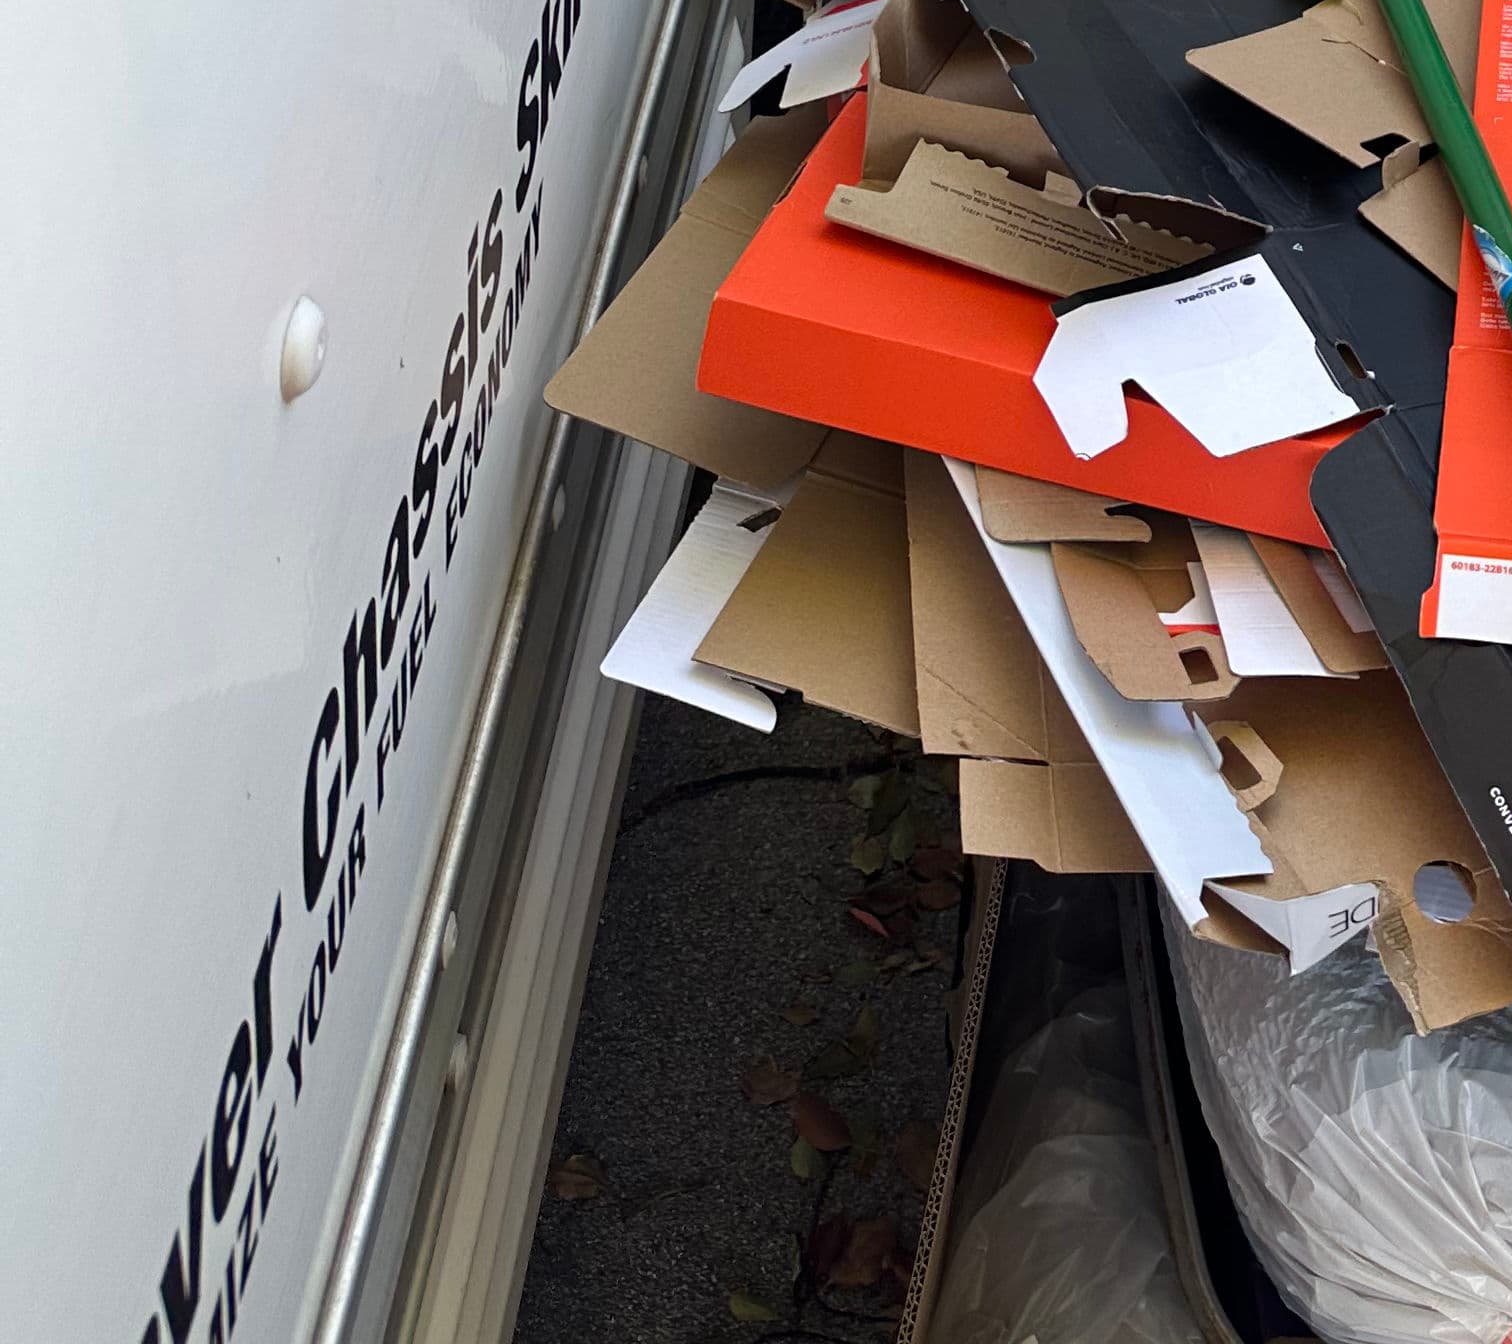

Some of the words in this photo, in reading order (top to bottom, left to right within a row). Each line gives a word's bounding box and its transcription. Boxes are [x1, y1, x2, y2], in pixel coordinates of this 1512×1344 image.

[140, 888, 283, 1344] ver
[303, 188, 503, 913] Chassis
[286, 802, 367, 1108] YOUR
[376, 569, 437, 814] FUEL
[445, 176, 543, 574] ECONOMY
